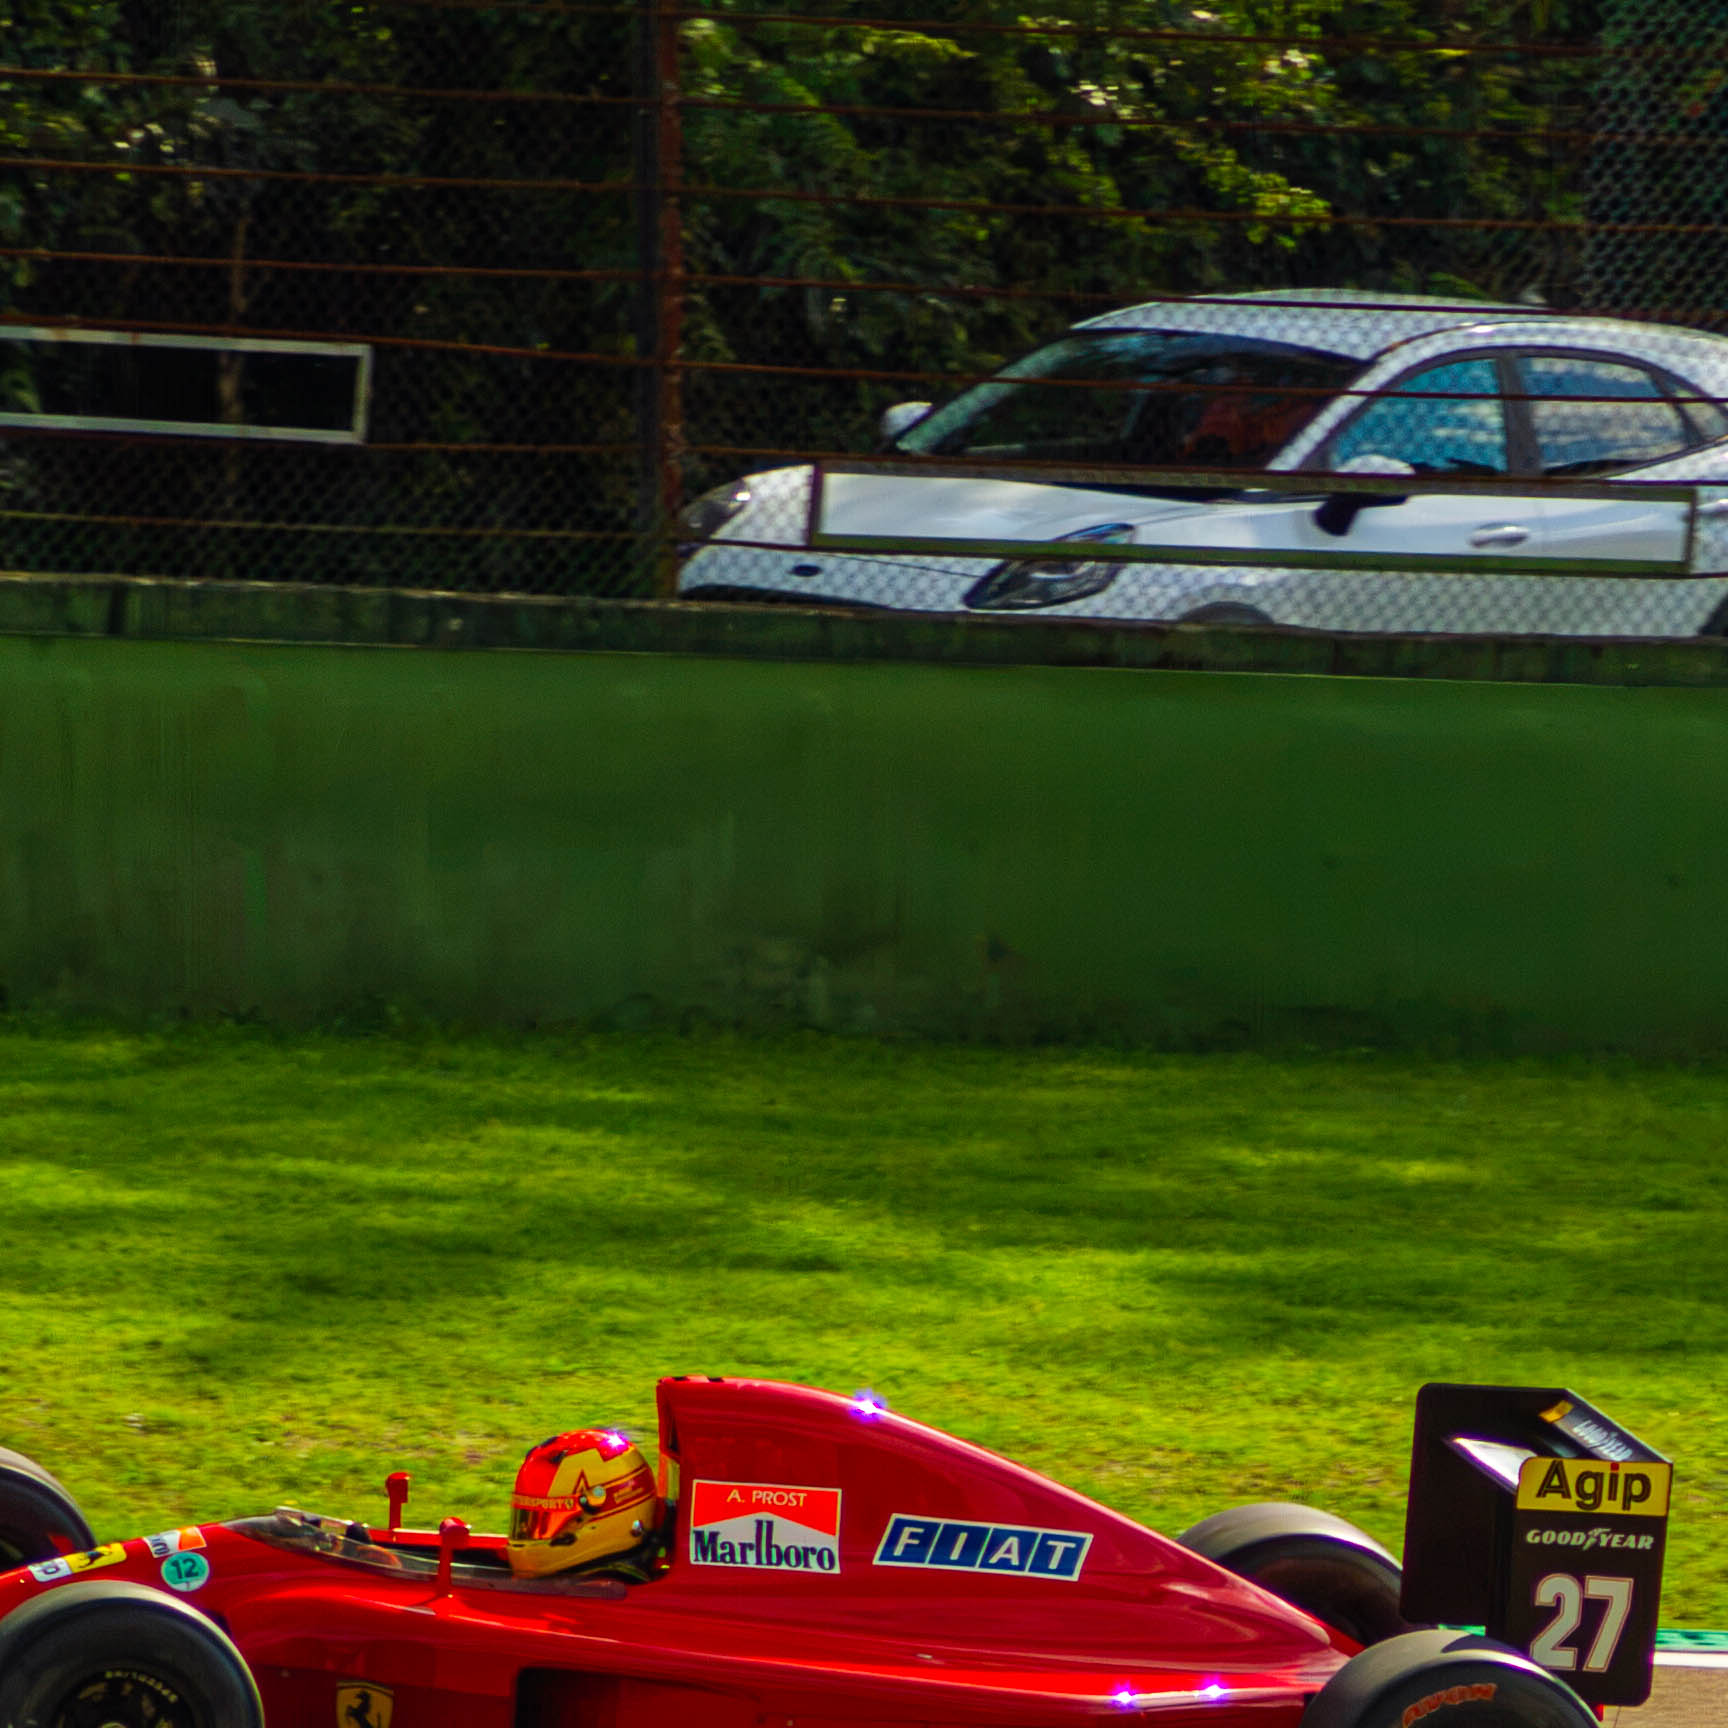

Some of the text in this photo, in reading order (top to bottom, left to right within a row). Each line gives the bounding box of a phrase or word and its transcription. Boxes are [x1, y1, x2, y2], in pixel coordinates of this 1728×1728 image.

[727, 1489, 808, 1507] A. PROST
[1535, 1459, 1652, 1511] Agip
[692, 1519, 836, 1572] Marlboro
[892, 1527, 1077, 1569] FIAT
[1525, 1528, 1655, 1550] GOODYEAR
[171, 1558, 200, 1580] 12
[1529, 1573, 1635, 1673] 27
